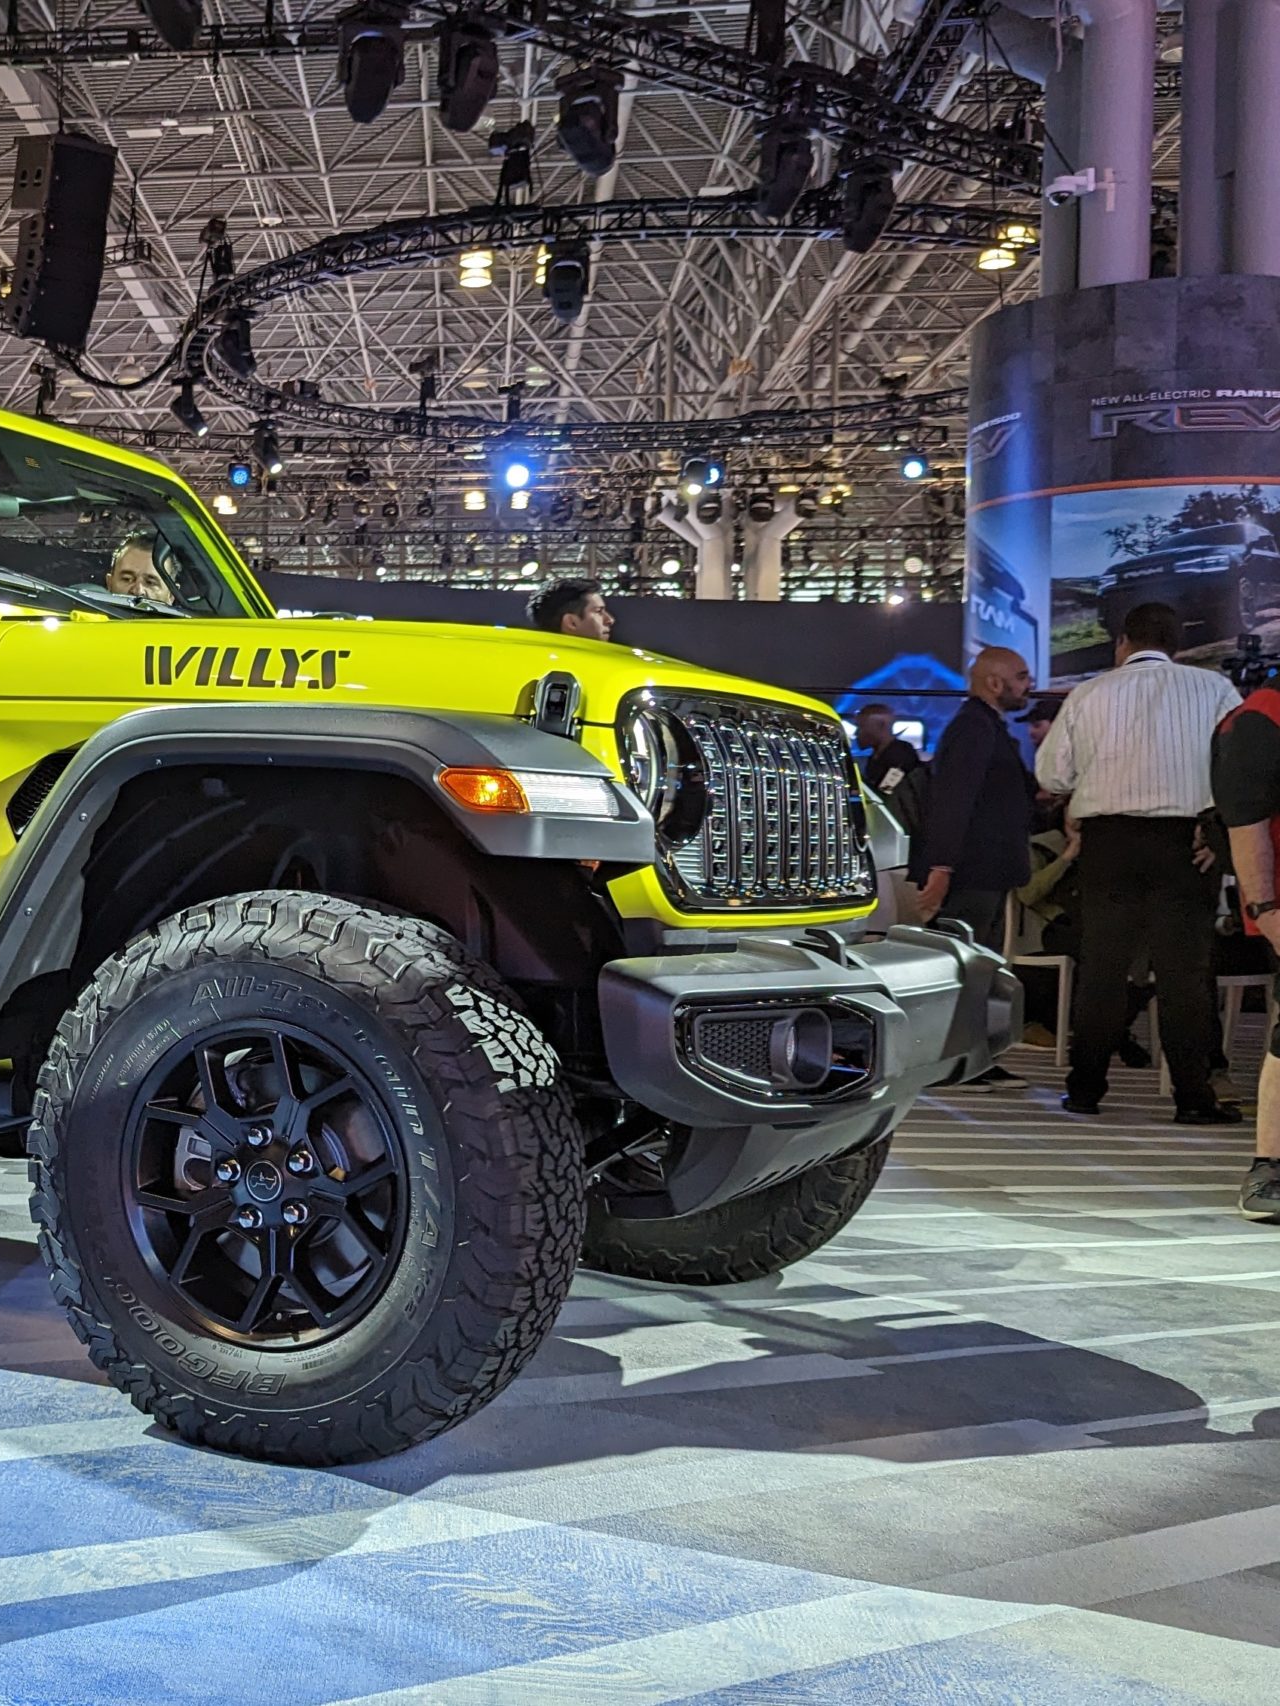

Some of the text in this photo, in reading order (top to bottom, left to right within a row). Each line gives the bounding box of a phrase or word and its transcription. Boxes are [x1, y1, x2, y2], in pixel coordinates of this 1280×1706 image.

[1091, 396, 1120, 406] NEW
[1122, 389, 1211, 404] ALL-ELECTRIC
[145, 646, 351, 689] WILLYS
